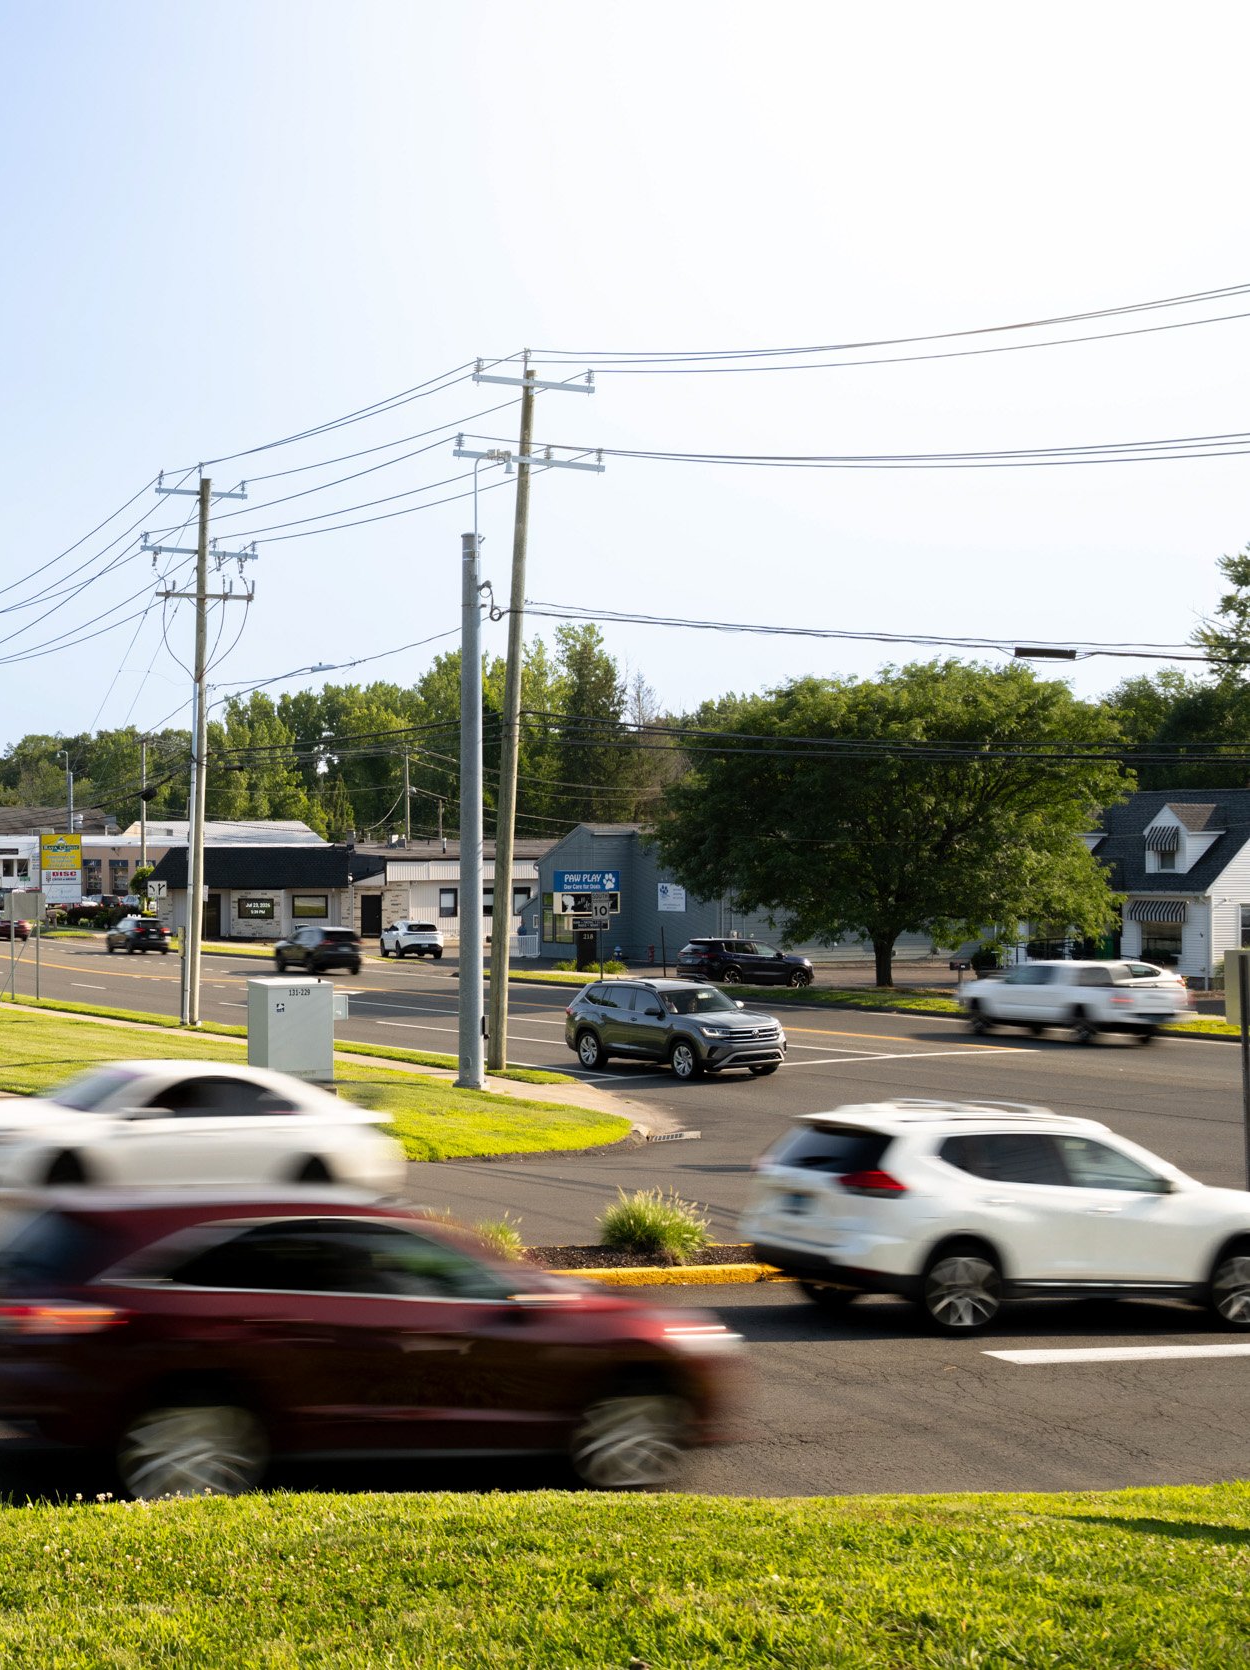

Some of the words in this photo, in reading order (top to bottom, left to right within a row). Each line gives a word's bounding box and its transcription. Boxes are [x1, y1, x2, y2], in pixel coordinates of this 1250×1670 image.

[564, 874, 582, 882] PAW
[582, 873, 602, 882] PLAY
[594, 905, 608, 916] 10
